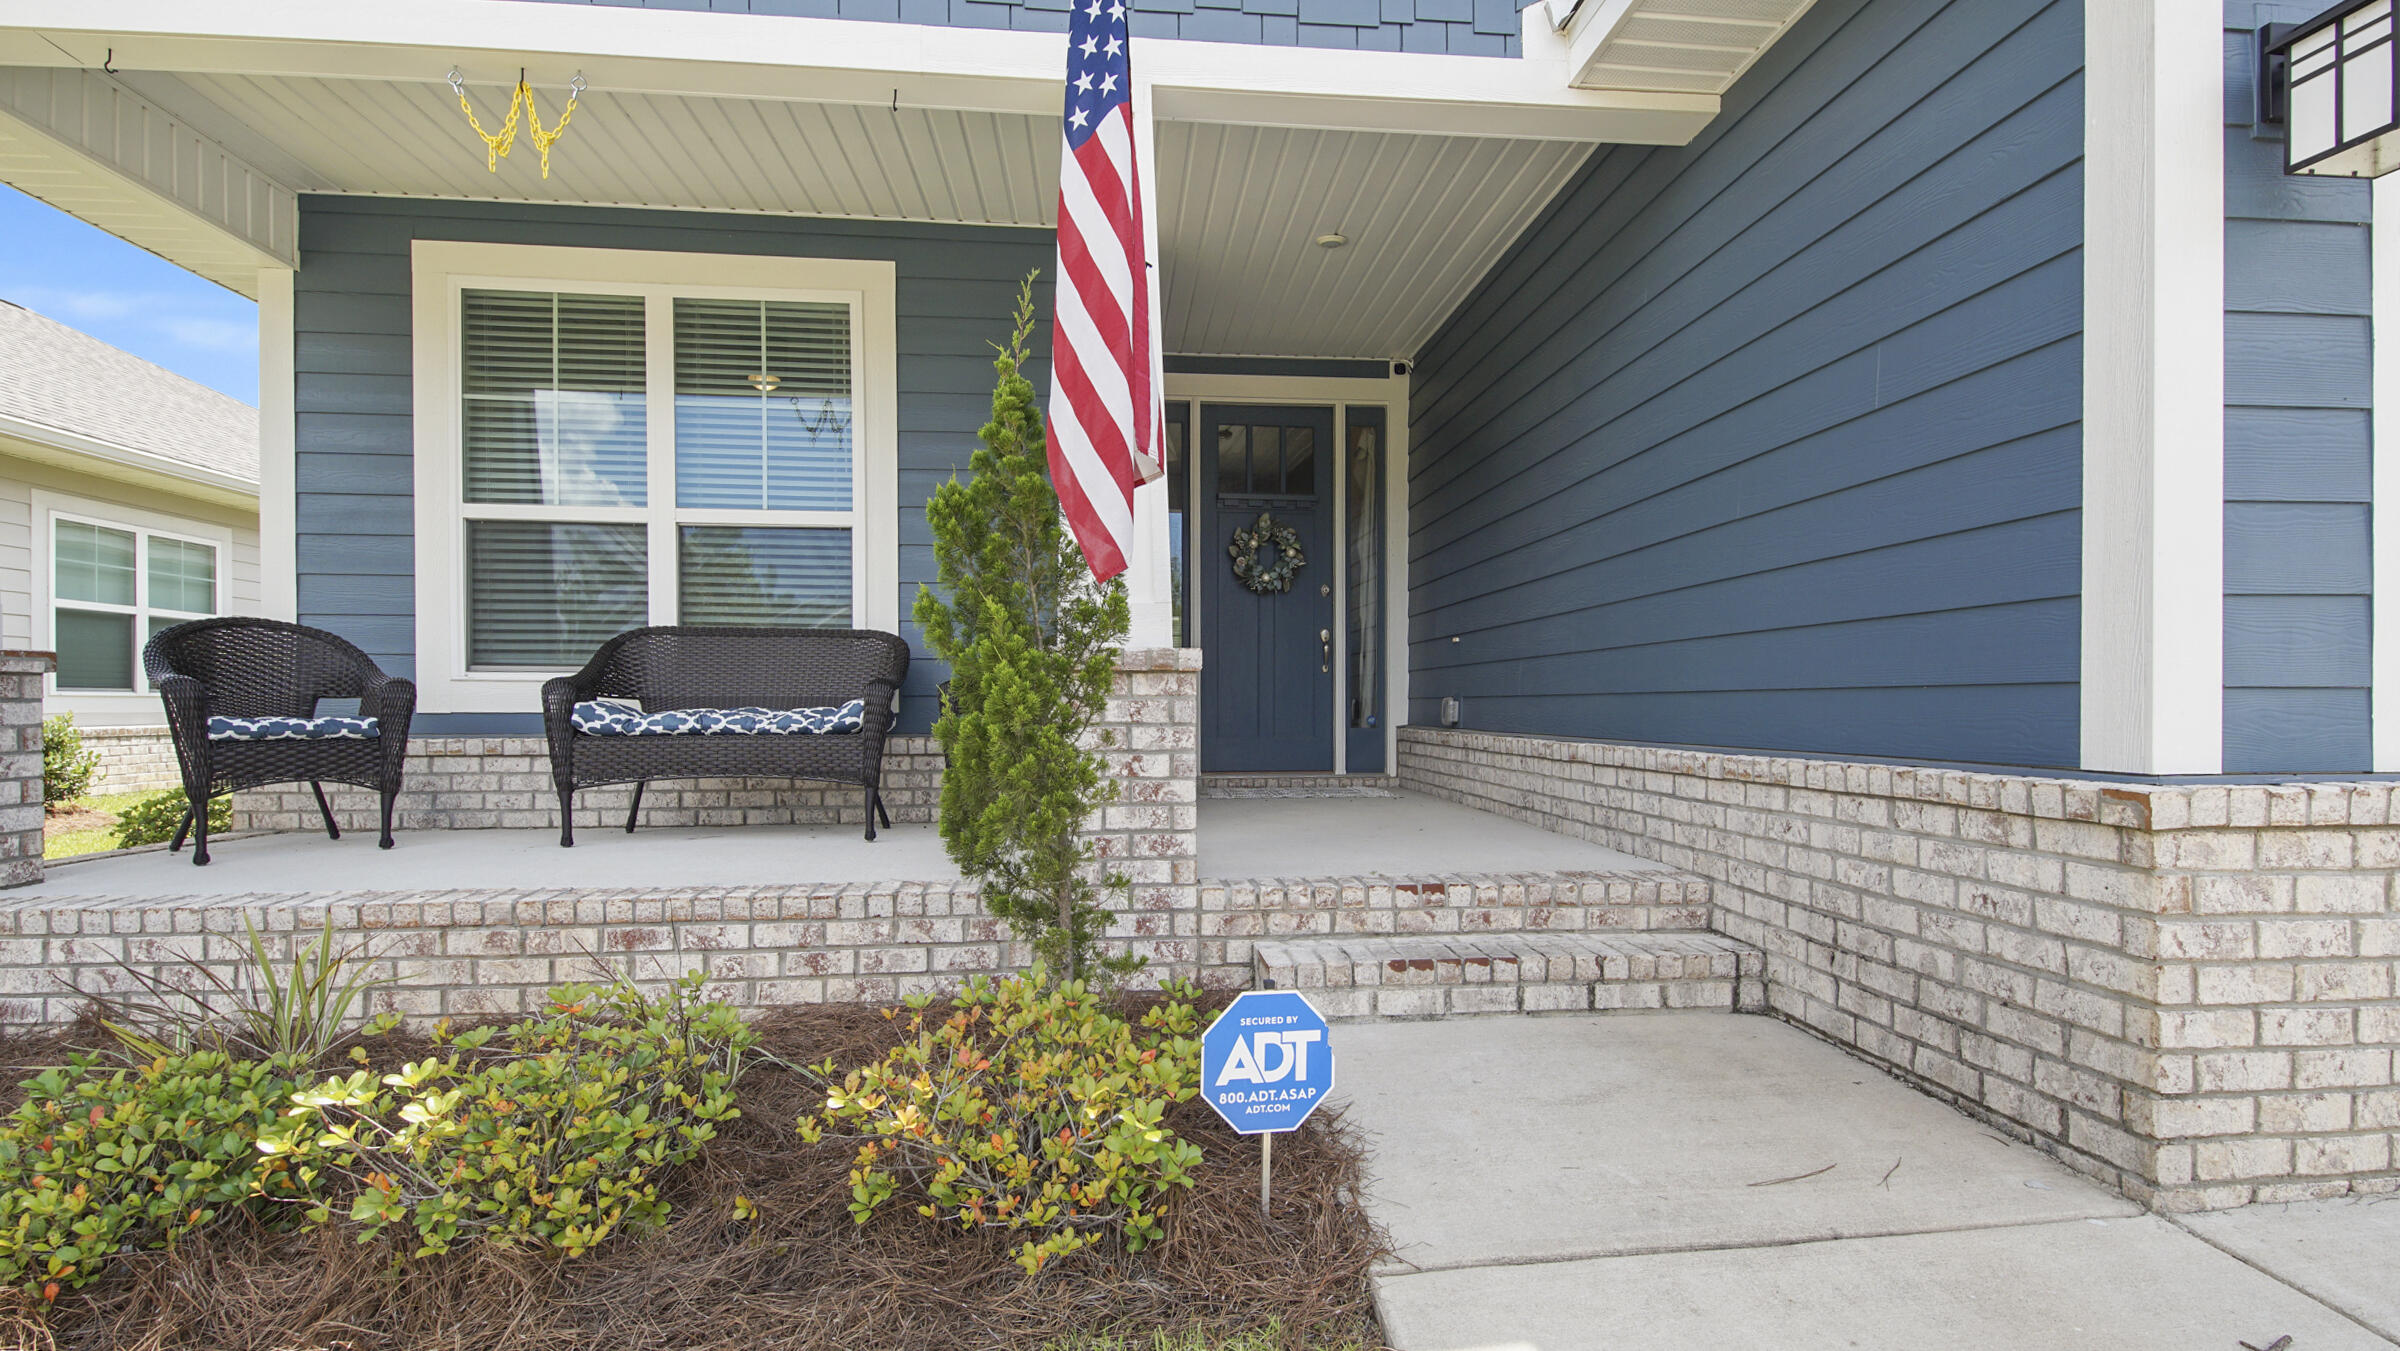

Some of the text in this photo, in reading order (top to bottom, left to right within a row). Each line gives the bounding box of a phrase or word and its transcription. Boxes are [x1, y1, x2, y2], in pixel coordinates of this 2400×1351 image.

[1240, 1015, 1298, 1026] SECURED BY
[1215, 1030, 1321, 1087] ADT
[1219, 1088, 1316, 1104] 800.ADT.ASAP
[1245, 1104, 1290, 1114] ADT.COM
